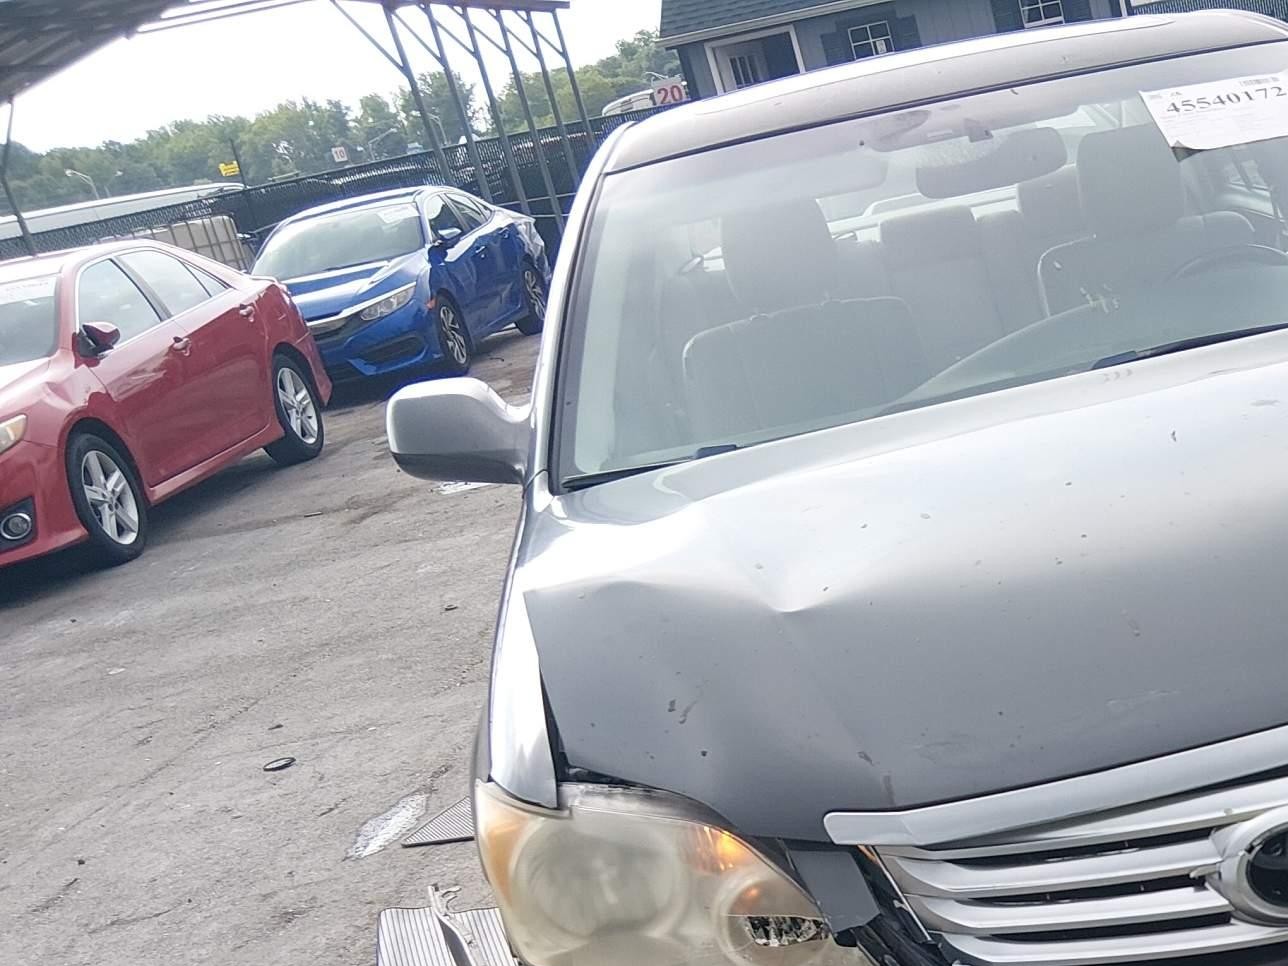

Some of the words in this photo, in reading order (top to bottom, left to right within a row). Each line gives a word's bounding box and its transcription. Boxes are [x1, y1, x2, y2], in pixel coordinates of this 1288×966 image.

[657, 85, 683, 104] 20
[1166, 86, 1288, 113] 45540172
[335, 150, 345, 159] 10
